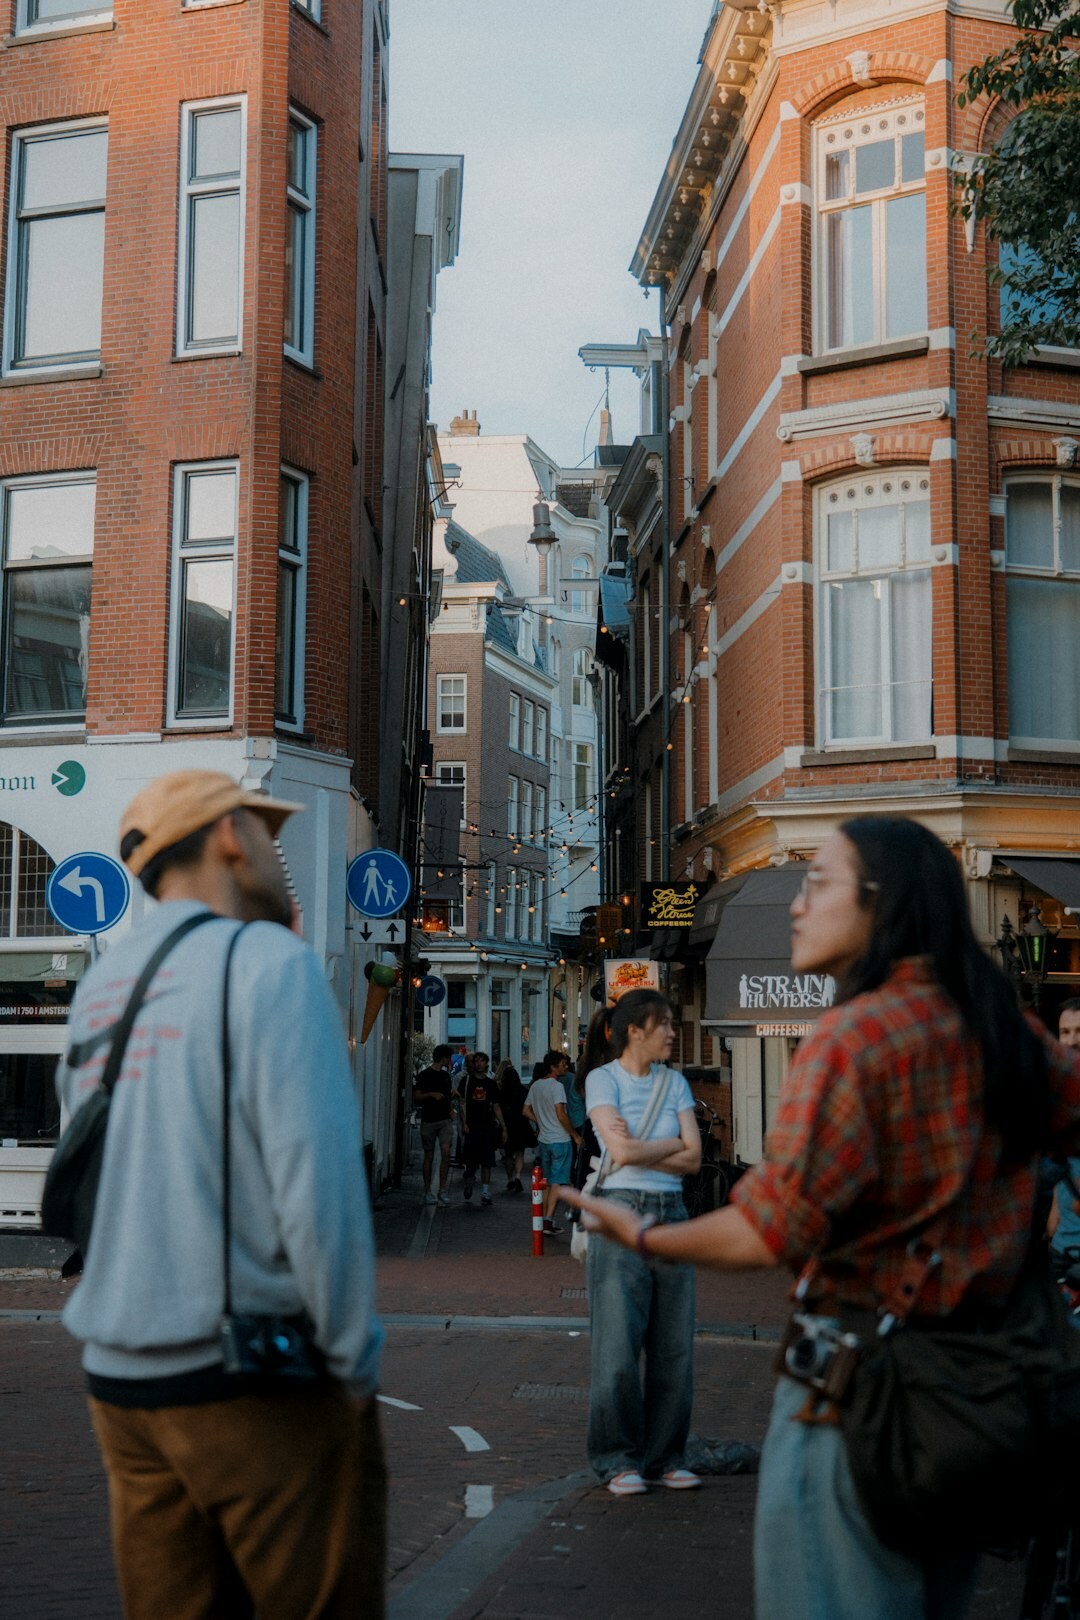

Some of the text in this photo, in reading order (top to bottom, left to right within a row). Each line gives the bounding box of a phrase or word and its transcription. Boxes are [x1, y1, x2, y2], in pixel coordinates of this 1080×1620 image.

[652, 888, 695, 906] Green
[652, 902, 696, 919] House
[748, 974, 825, 994] STRAIN
[747, 992, 822, 1008] HUNTERS
[21, 1006, 34, 1015] 750
[756, 1023, 817, 1036] COFFEESHO
